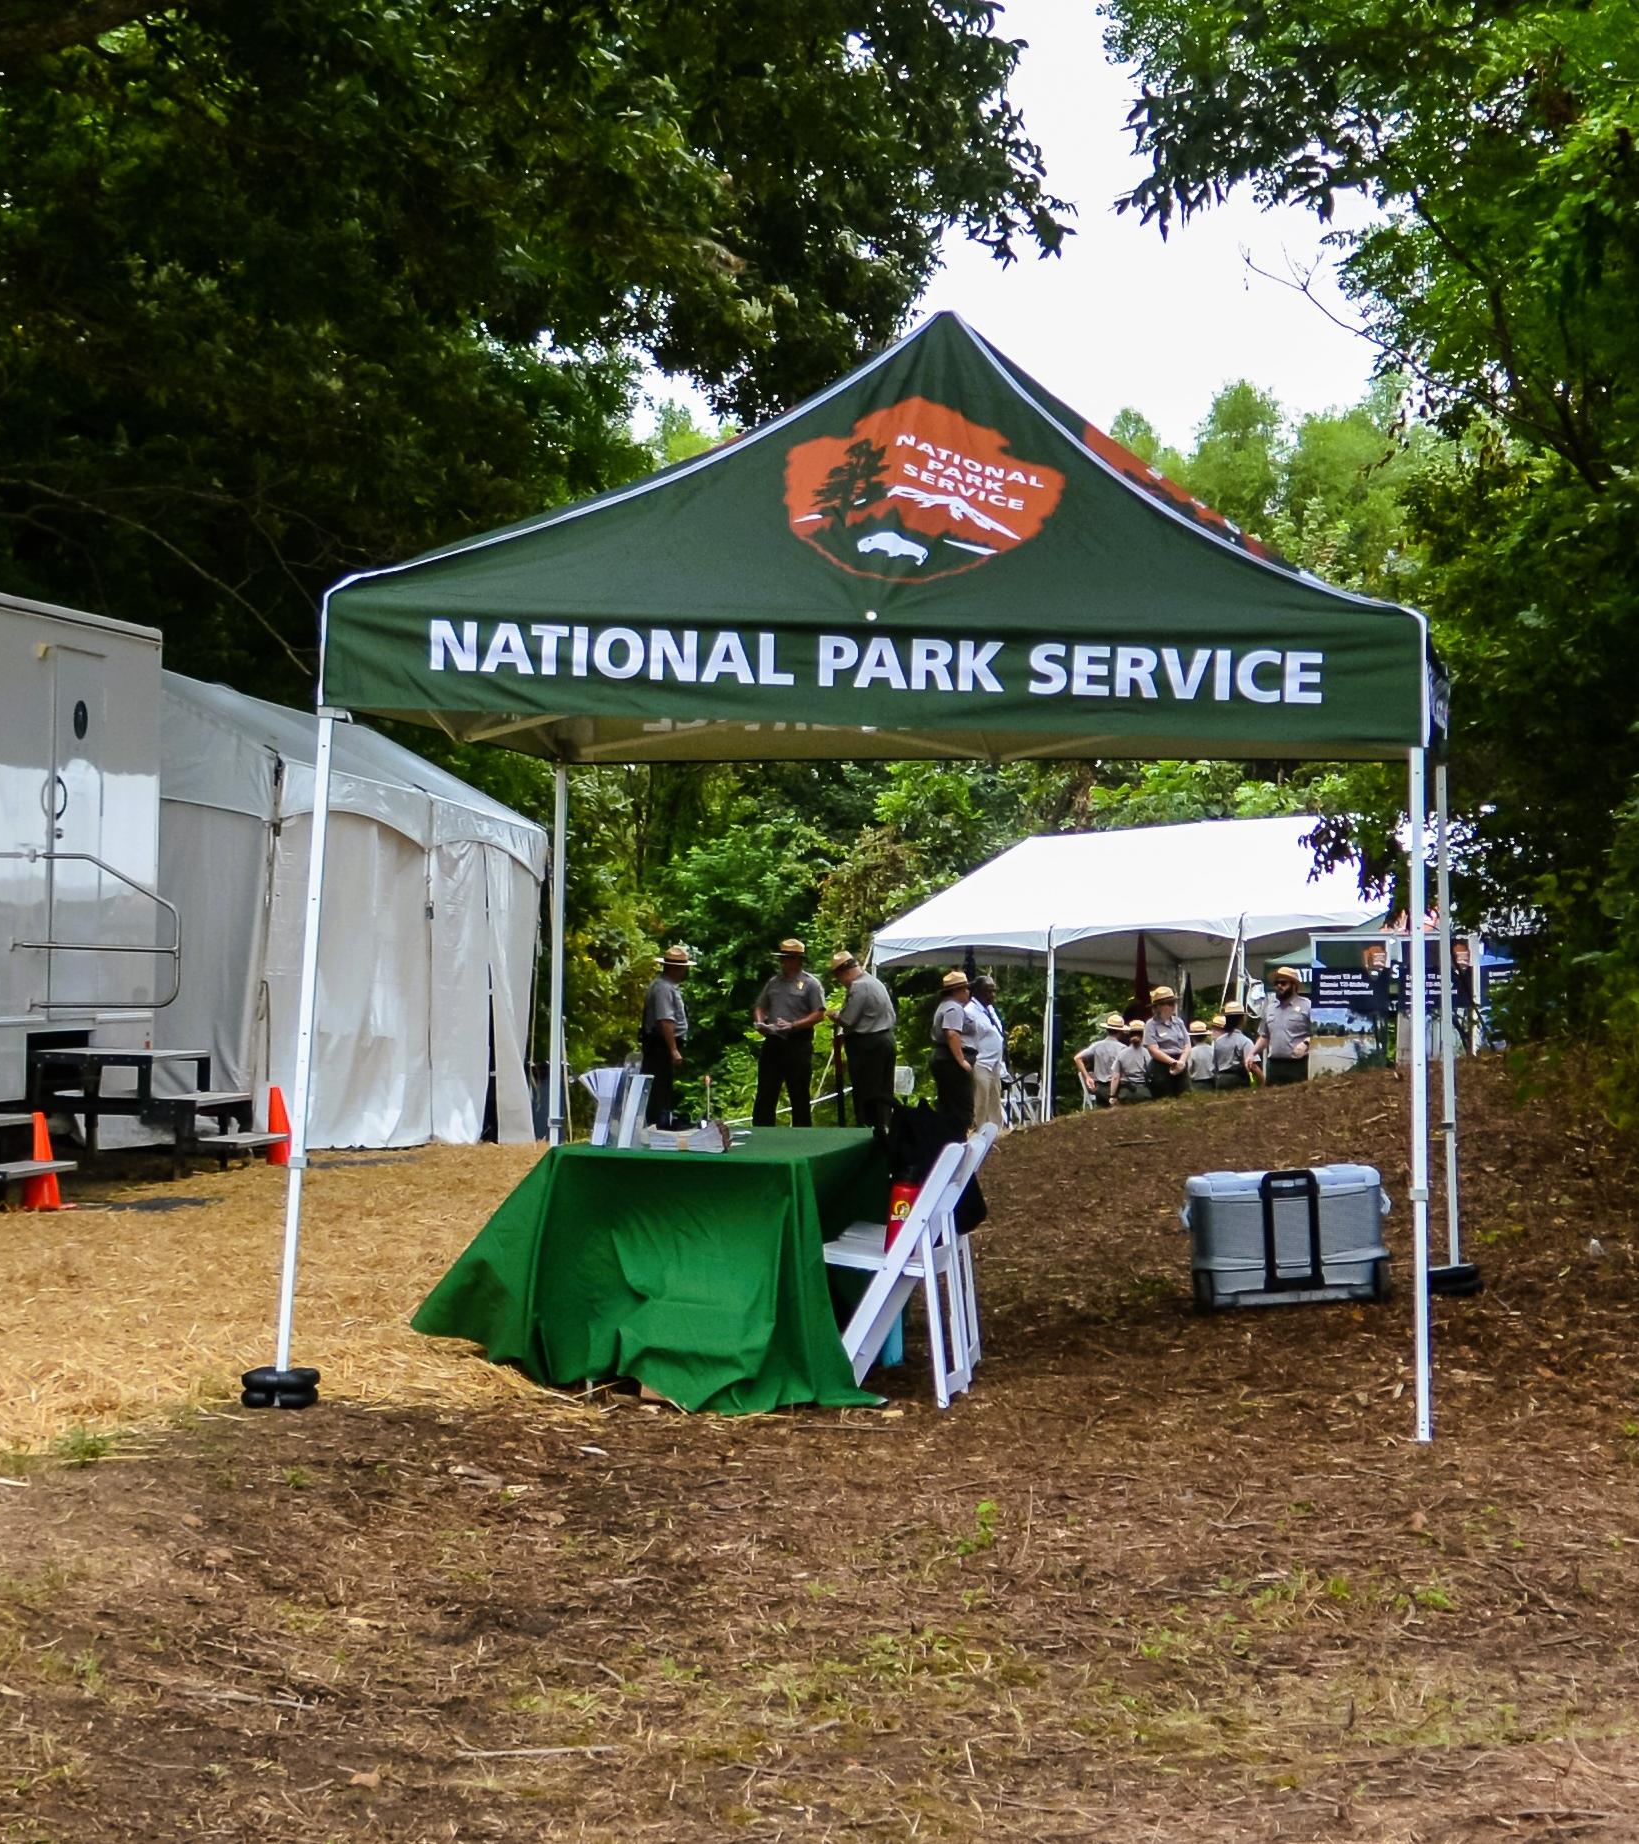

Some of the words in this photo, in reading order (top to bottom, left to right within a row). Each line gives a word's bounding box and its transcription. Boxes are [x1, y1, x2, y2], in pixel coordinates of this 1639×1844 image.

[895, 434, 1045, 488] NATIONAL
[927, 459, 1004, 492] PARK
[903, 463, 1025, 510] SERVICE
[429, 619, 794, 686] NATIONAL
[818, 635, 1004, 692] PARK
[1028, 643, 1323, 704] SERVICE
